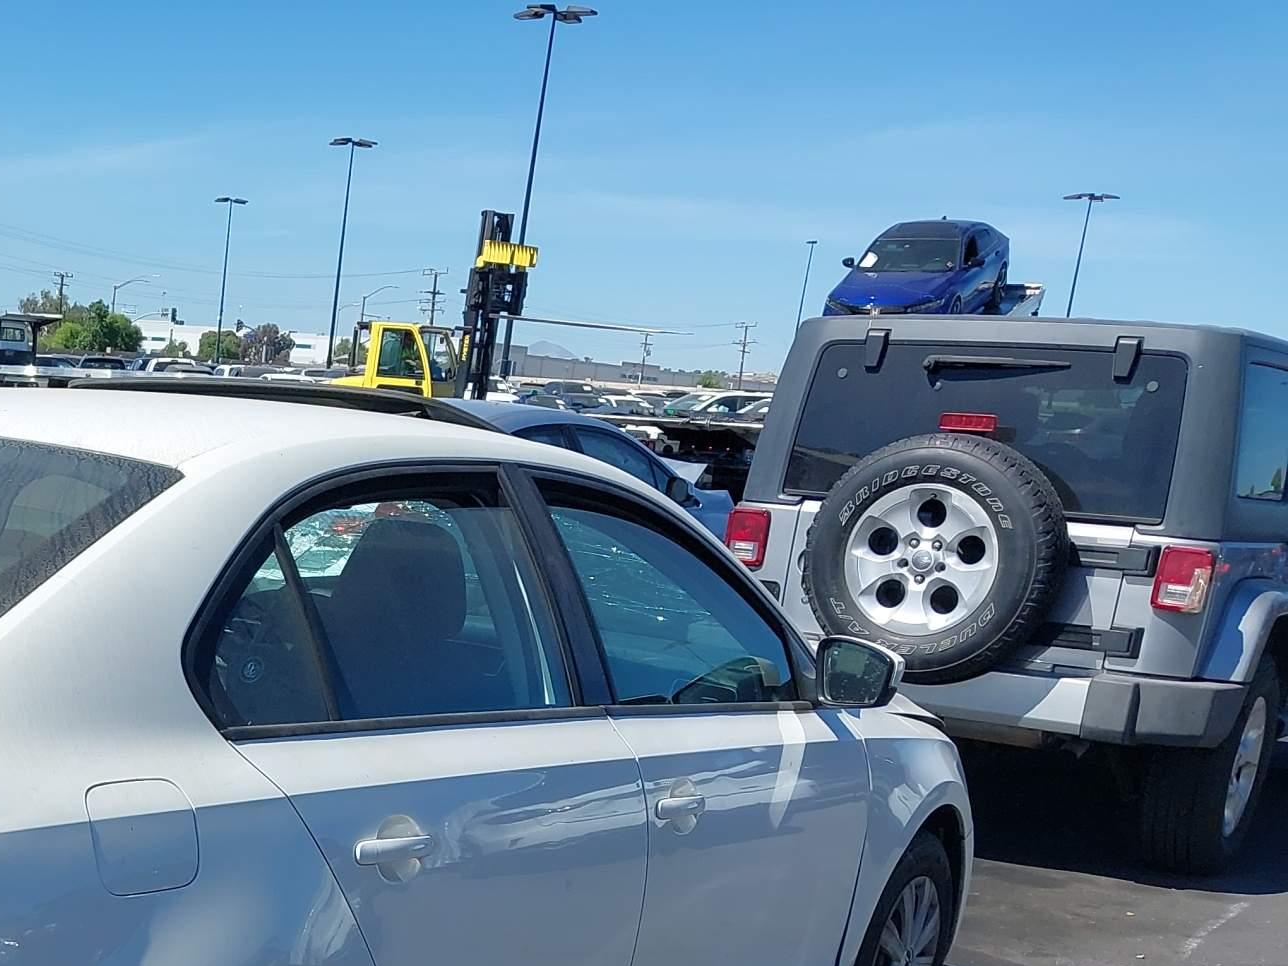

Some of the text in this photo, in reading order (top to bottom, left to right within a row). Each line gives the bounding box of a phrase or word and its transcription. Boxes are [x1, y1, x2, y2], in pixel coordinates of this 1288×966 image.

[838, 464, 1014, 530] BRIDGESTONE
[829, 597, 995, 655] DUELER A/T
